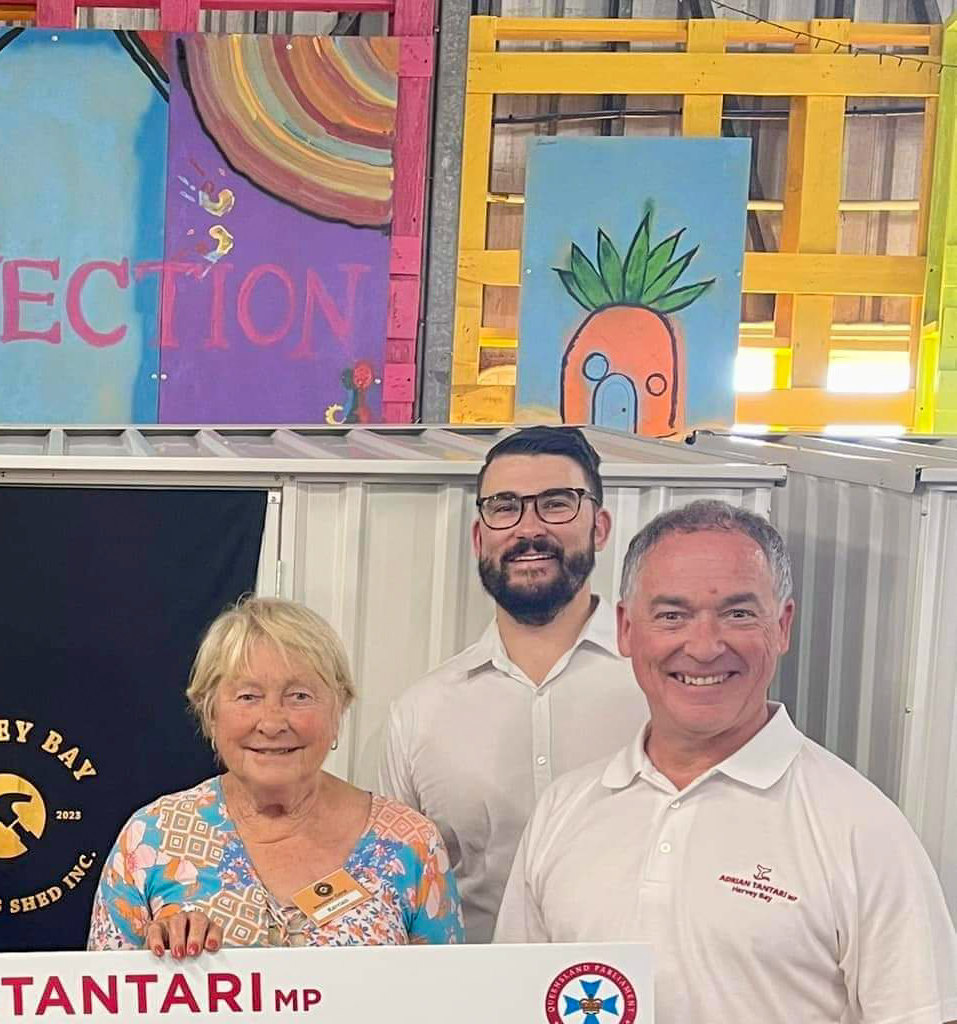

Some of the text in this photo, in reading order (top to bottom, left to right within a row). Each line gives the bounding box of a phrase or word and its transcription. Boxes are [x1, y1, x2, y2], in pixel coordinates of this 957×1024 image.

[41, 730, 97, 781] BAY
[55, 811, 82, 820] 2023
[10, 886, 63, 913] SHED
[62, 852, 97, 889] INC.
[719, 875, 751, 887] ADRIAN
[753, 881, 788, 898] TANTARI
[732, 886, 772, 903] Hervey Bay
[1, 972, 261, 1016] TANTARI
[274, 988, 322, 1012] MP
[547, 965, 590, 1013] QUEENSLAND
